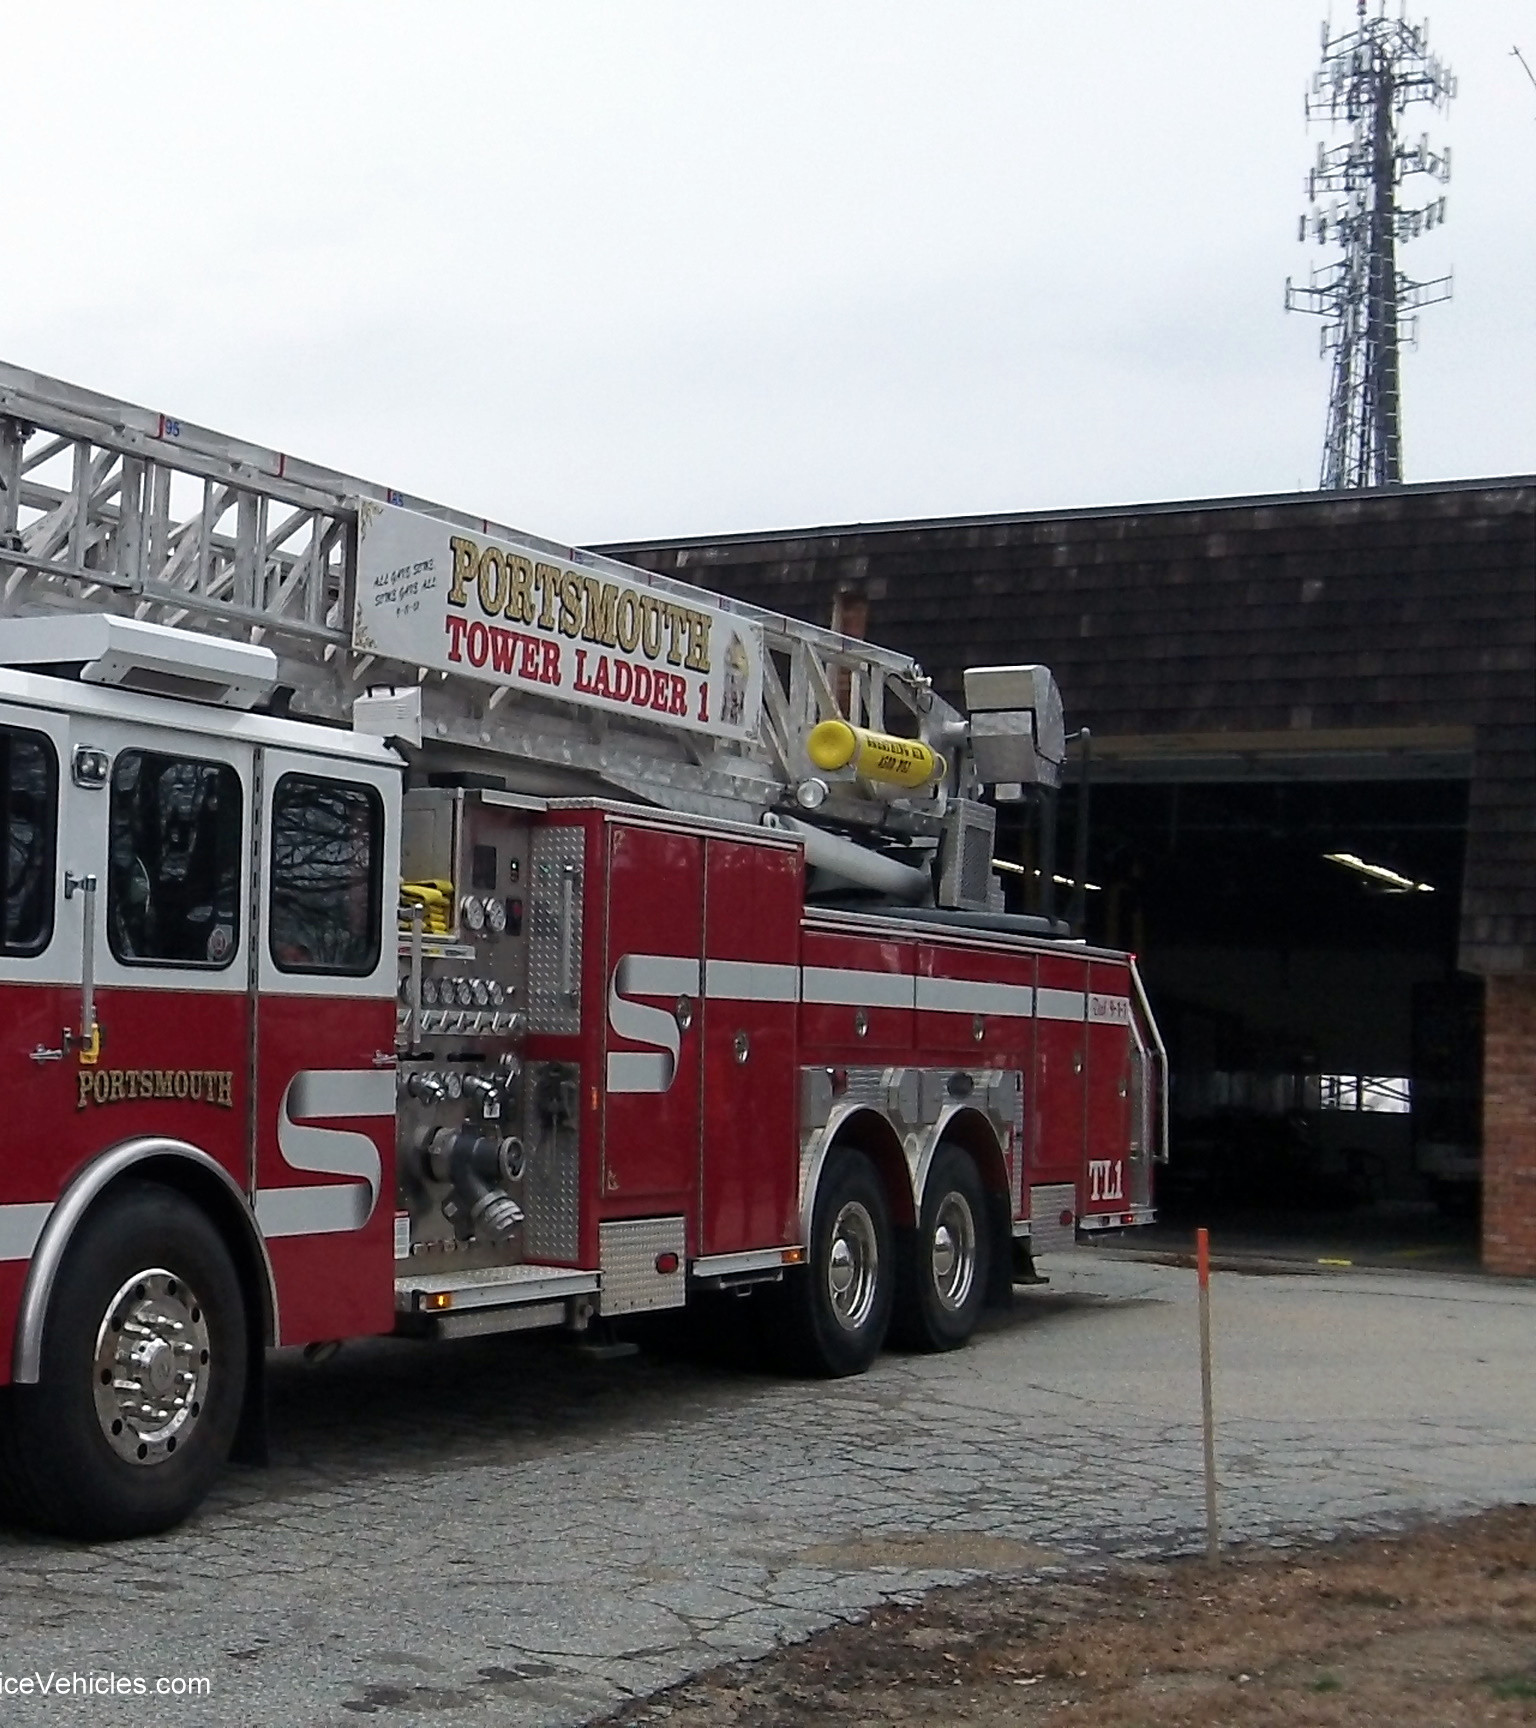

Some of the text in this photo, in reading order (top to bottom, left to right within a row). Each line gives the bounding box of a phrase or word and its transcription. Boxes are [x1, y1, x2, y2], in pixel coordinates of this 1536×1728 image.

[447, 535, 713, 675] PORTSMOUTH
[446, 614, 710, 723] TOWER LADDER 1
[77, 1069, 234, 1109] PORTSMOUTH
[1088, 1159, 1124, 1201] TL1
